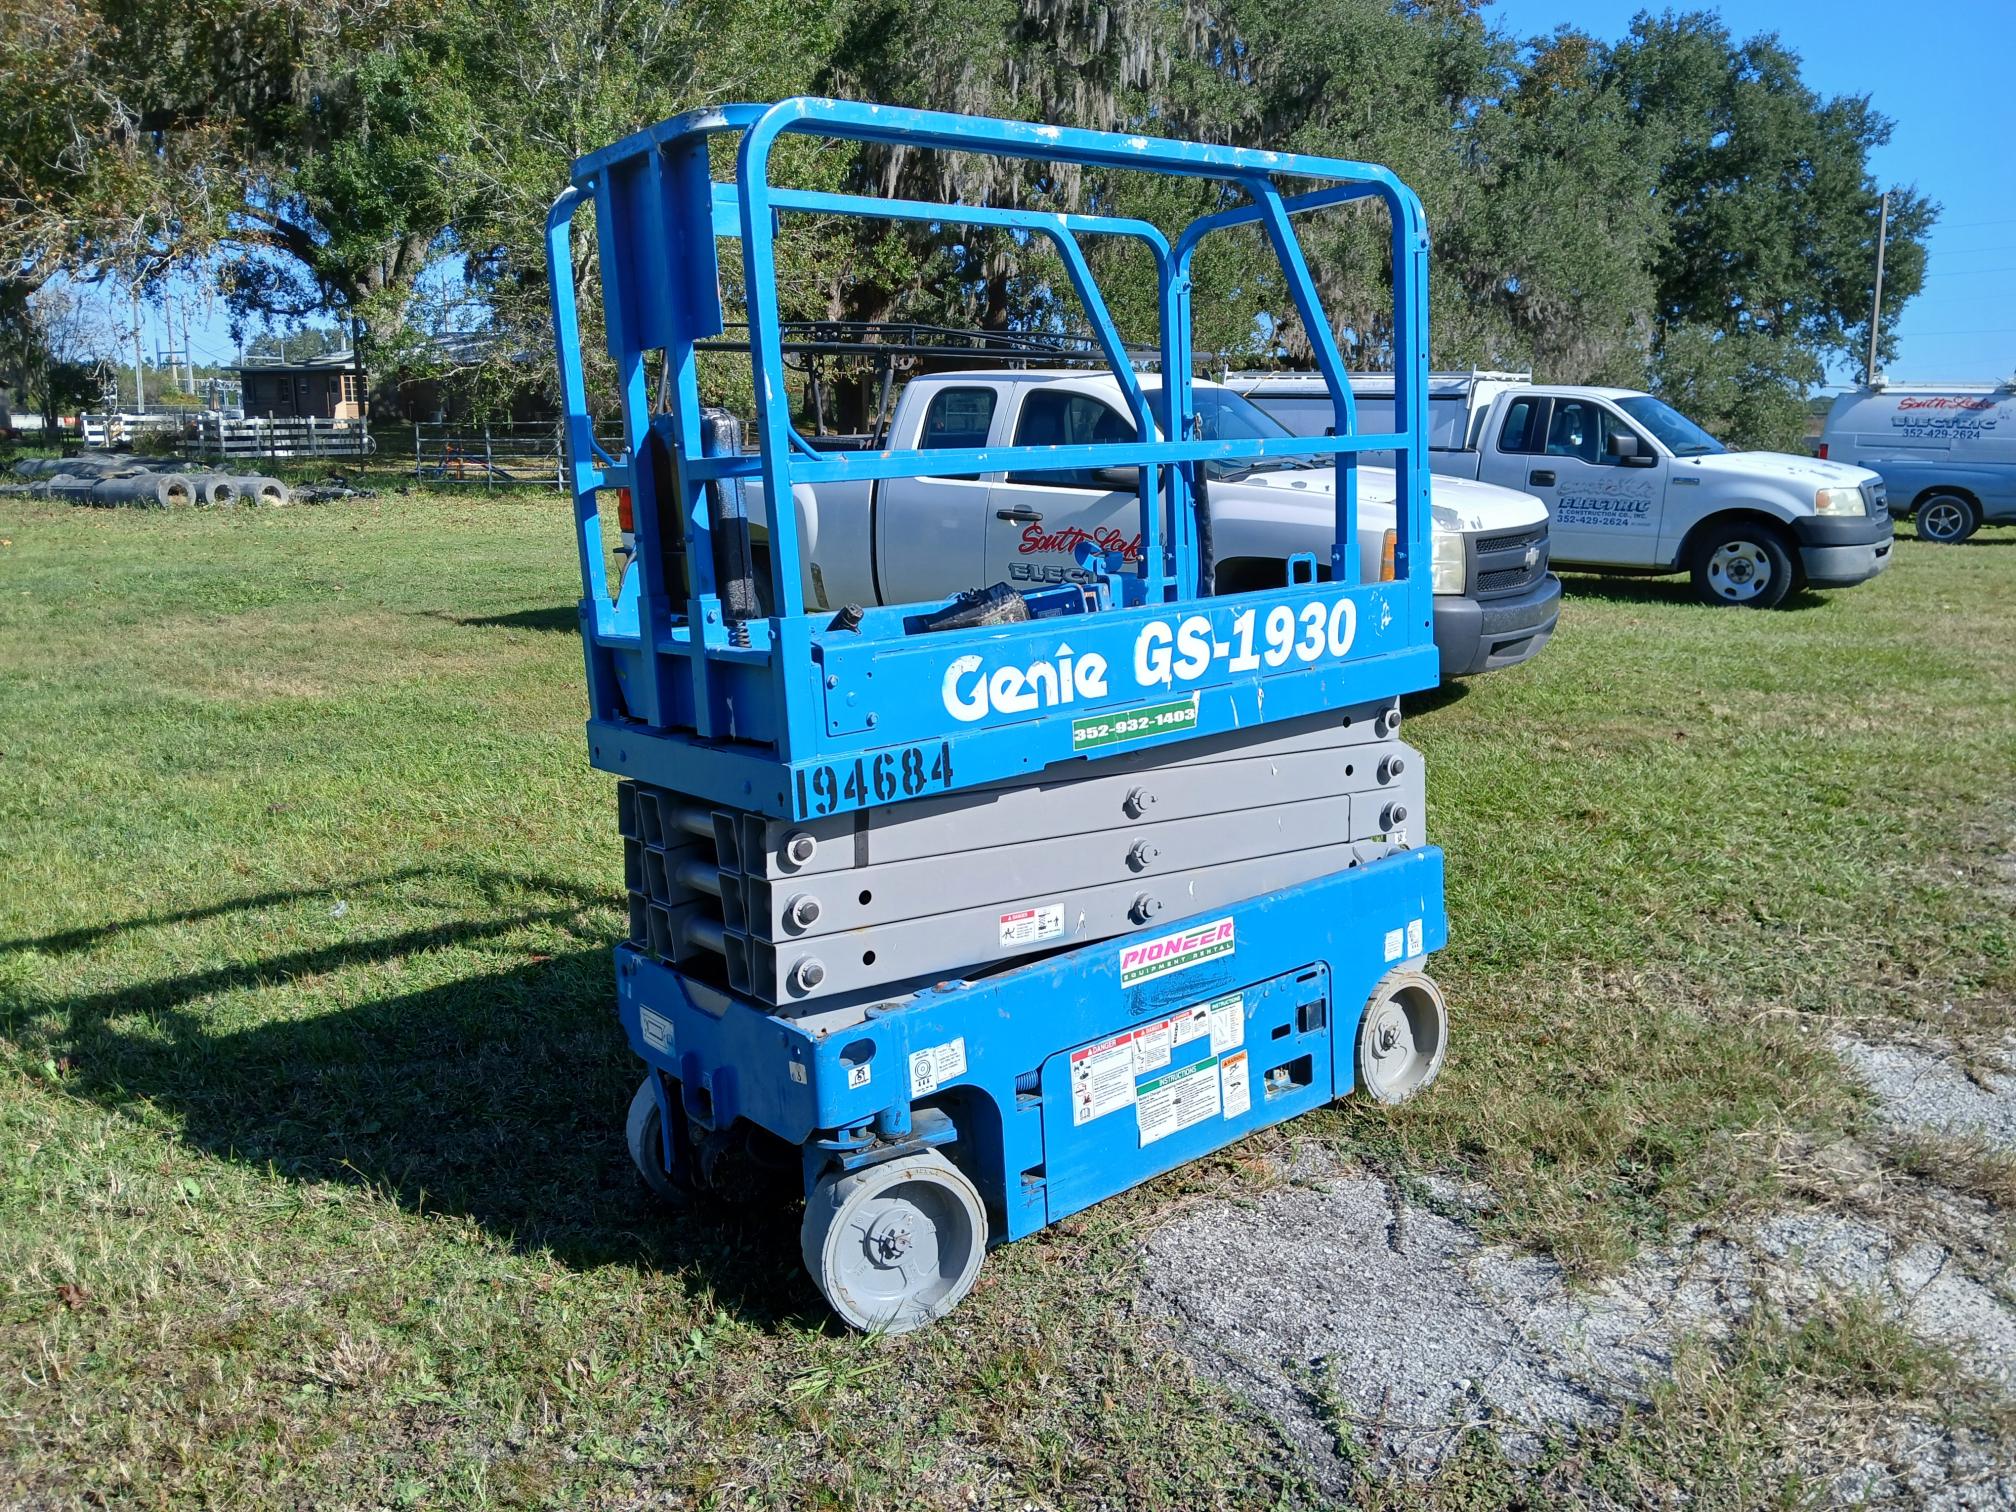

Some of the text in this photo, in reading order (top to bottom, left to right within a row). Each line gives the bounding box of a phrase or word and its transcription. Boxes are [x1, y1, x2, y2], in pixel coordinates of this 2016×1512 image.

[1898, 397, 1946, 410] South
[1891, 416, 1997, 430] ELECTRIC
[1902, 428, 1981, 440] 352-429-2624
[1558, 497, 1651, 512] ELECTRIC
[1557, 514, 1629, 526] 352-429-2624
[1093, 526, 1141, 562] Lak
[942, 598, 1357, 722] Genie GS-1930
[1074, 709, 1196, 742] 352-932-1403
[796, 741, 954, 819] 194684
[1122, 922, 1232, 970] PIONEER
[1123, 943, 1231, 981] EQUIPMENT RENTAL
[1092, 1039, 1117, 1055] DANGER
[1159, 1066, 1197, 1086] INSTRUCTIONS
